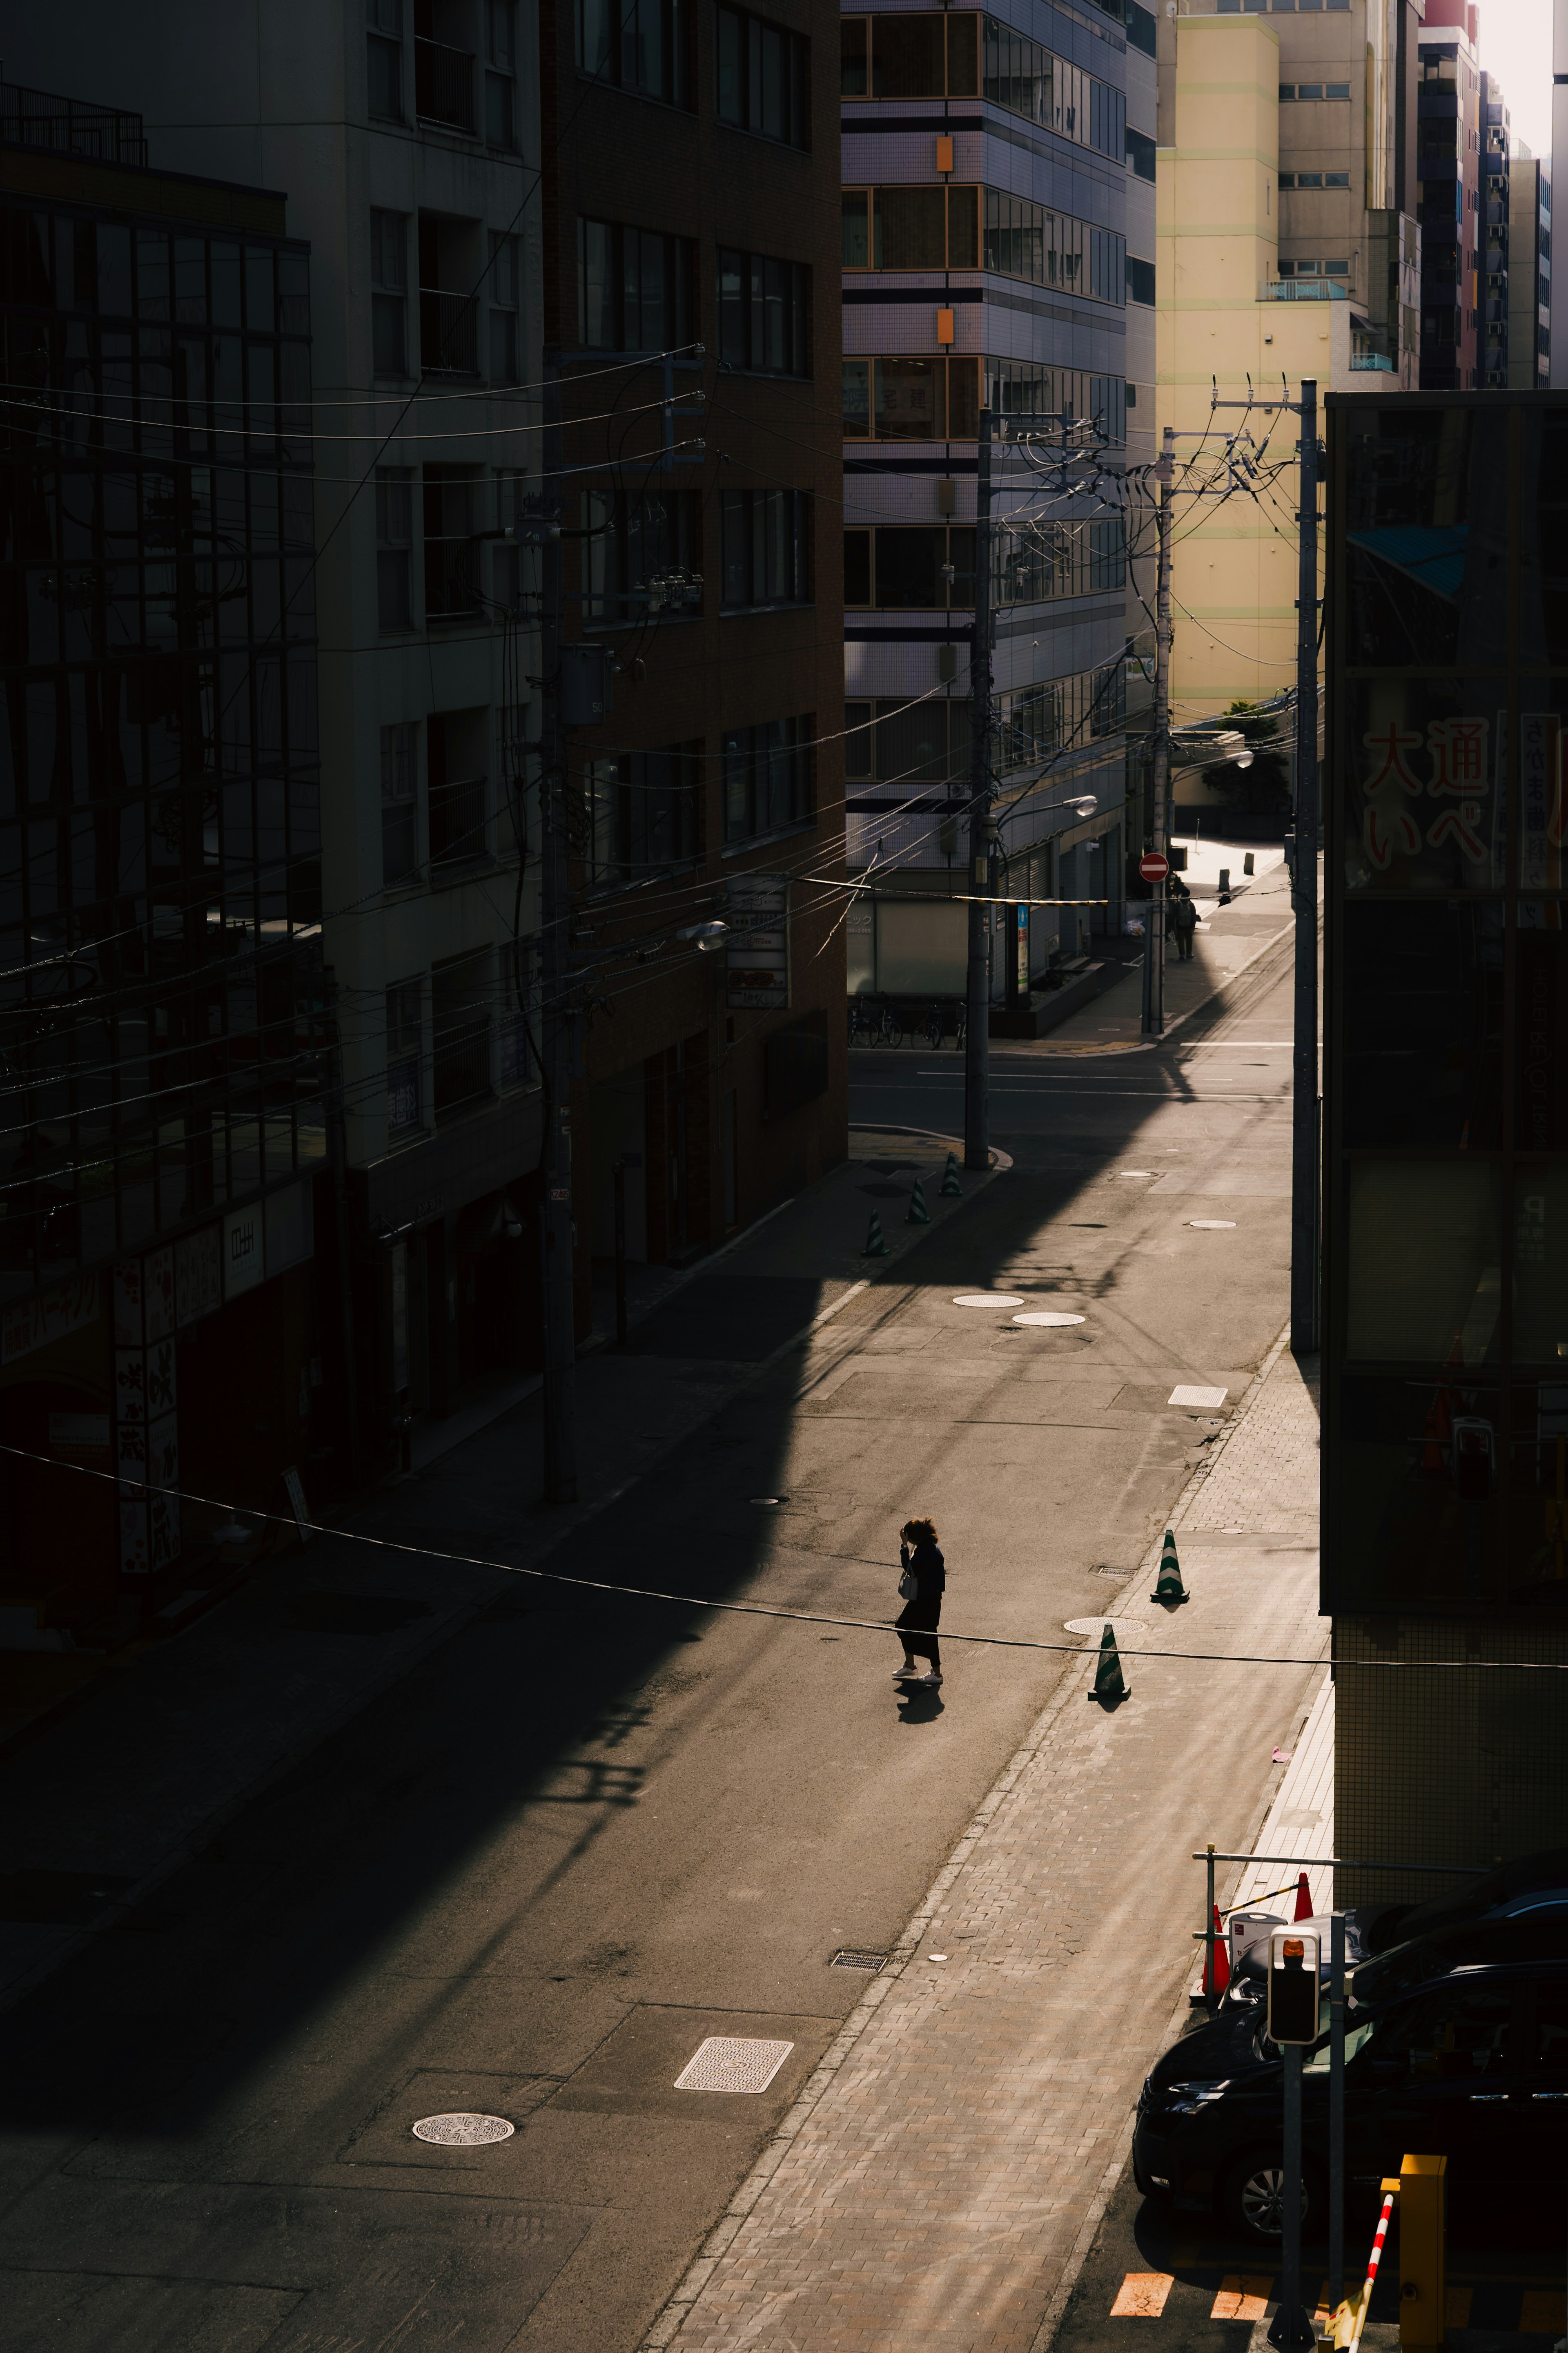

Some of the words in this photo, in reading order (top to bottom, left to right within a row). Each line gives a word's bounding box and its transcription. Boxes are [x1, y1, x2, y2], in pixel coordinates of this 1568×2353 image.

[1366, 719, 1486, 795] 大通
[731, 974, 771, 984] ラーメン
[550, 1190, 568, 1199] K2485
[150, 1424, 175, 1445] Sakagura
